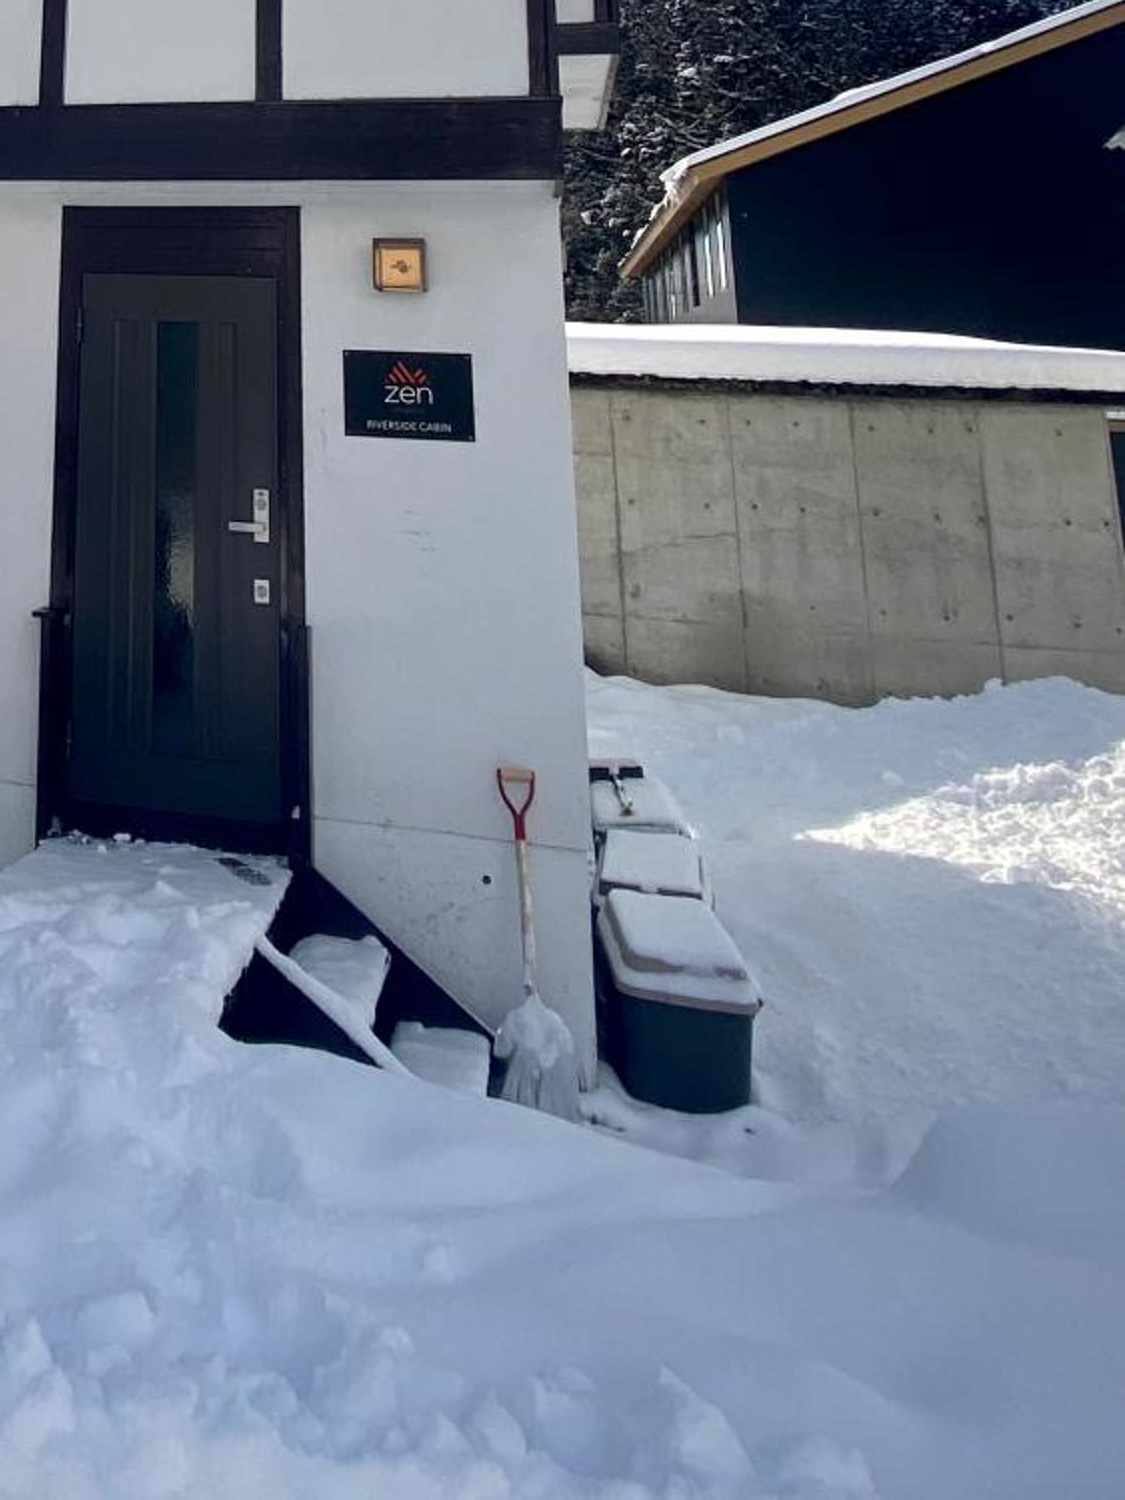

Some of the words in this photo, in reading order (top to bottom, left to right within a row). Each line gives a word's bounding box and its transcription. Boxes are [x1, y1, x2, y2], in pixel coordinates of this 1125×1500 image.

[384, 385, 434, 405] zen
[366, 419, 417, 432] RIVERSIDE
[418, 420, 452, 433] CABIN
